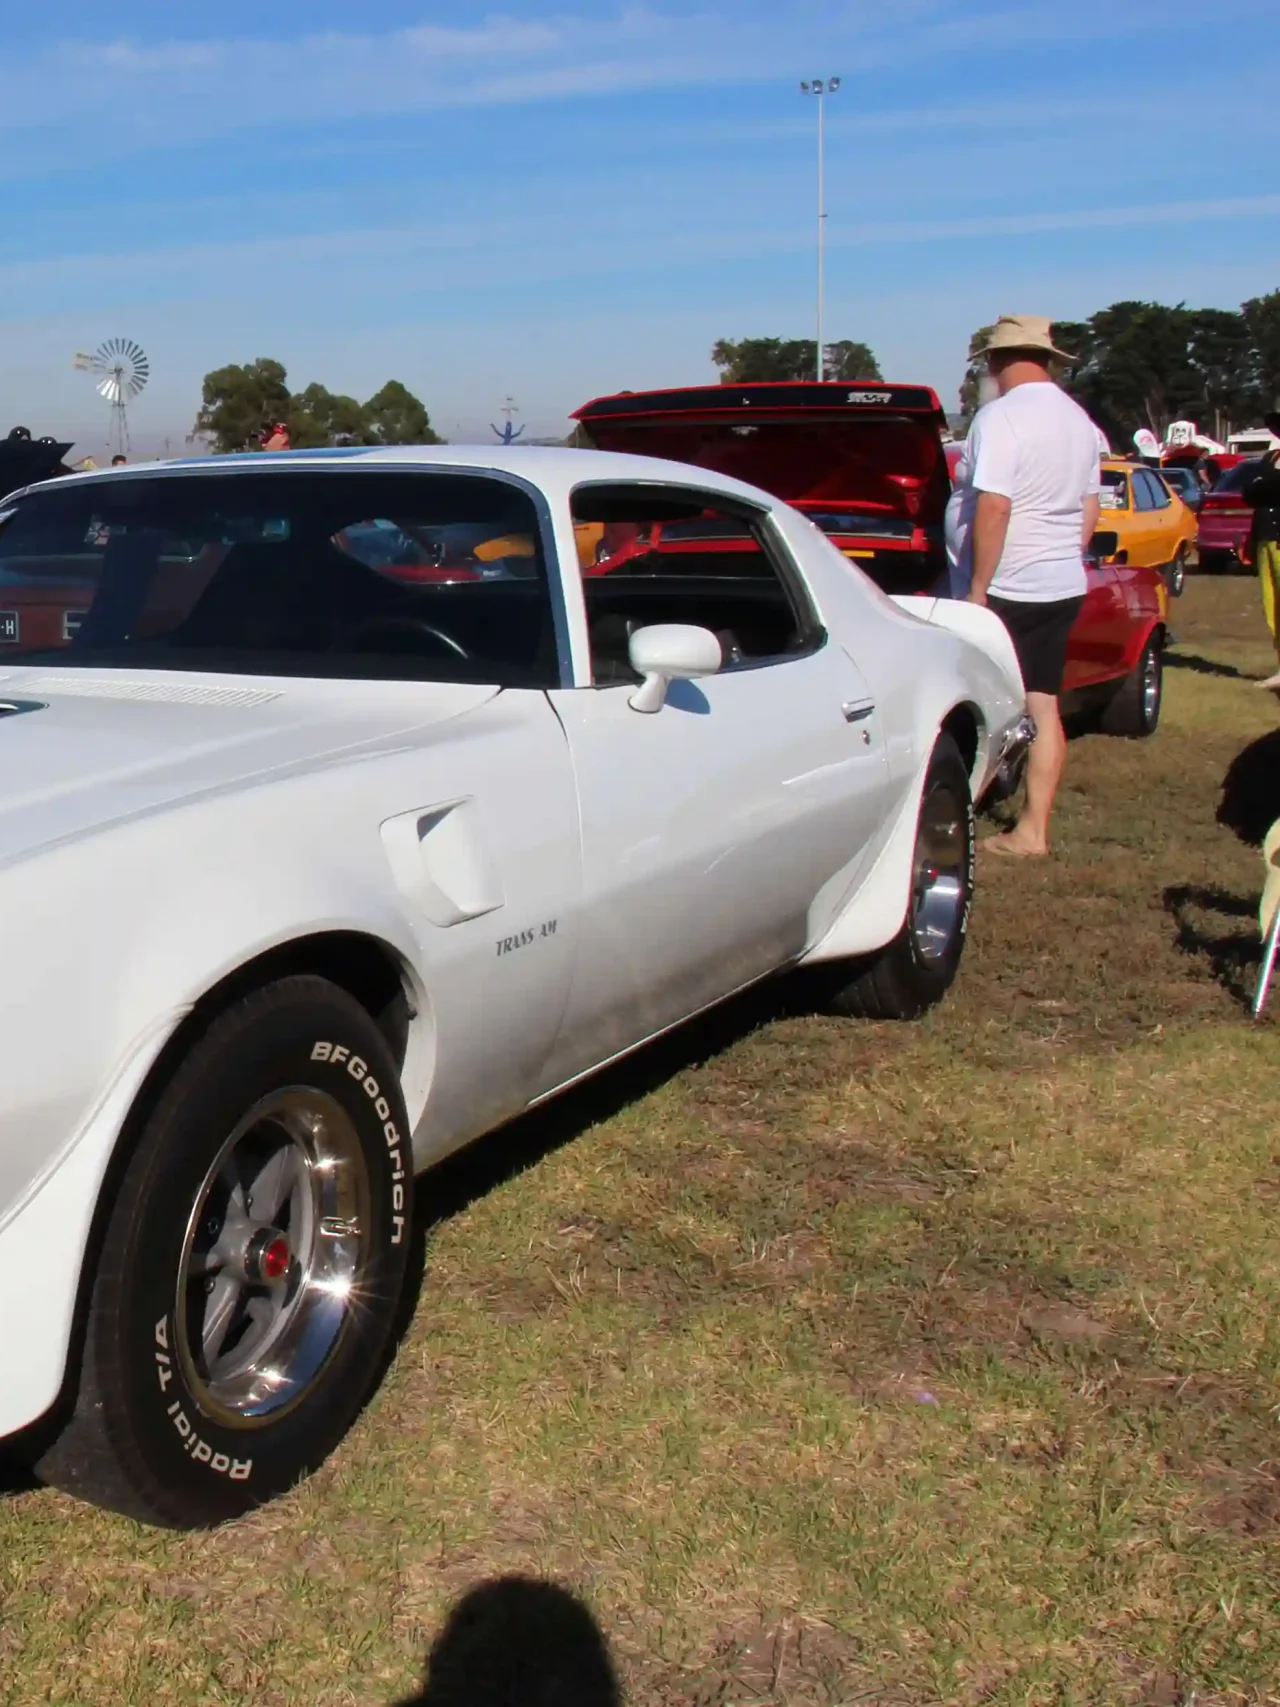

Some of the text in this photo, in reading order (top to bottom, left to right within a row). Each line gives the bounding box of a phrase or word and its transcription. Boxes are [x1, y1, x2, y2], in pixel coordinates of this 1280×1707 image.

[495, 919, 557, 956] TRANS AM
[310, 1041, 405, 1244] BFGoodrich
[155, 1314, 252, 1479] Radial T/A
